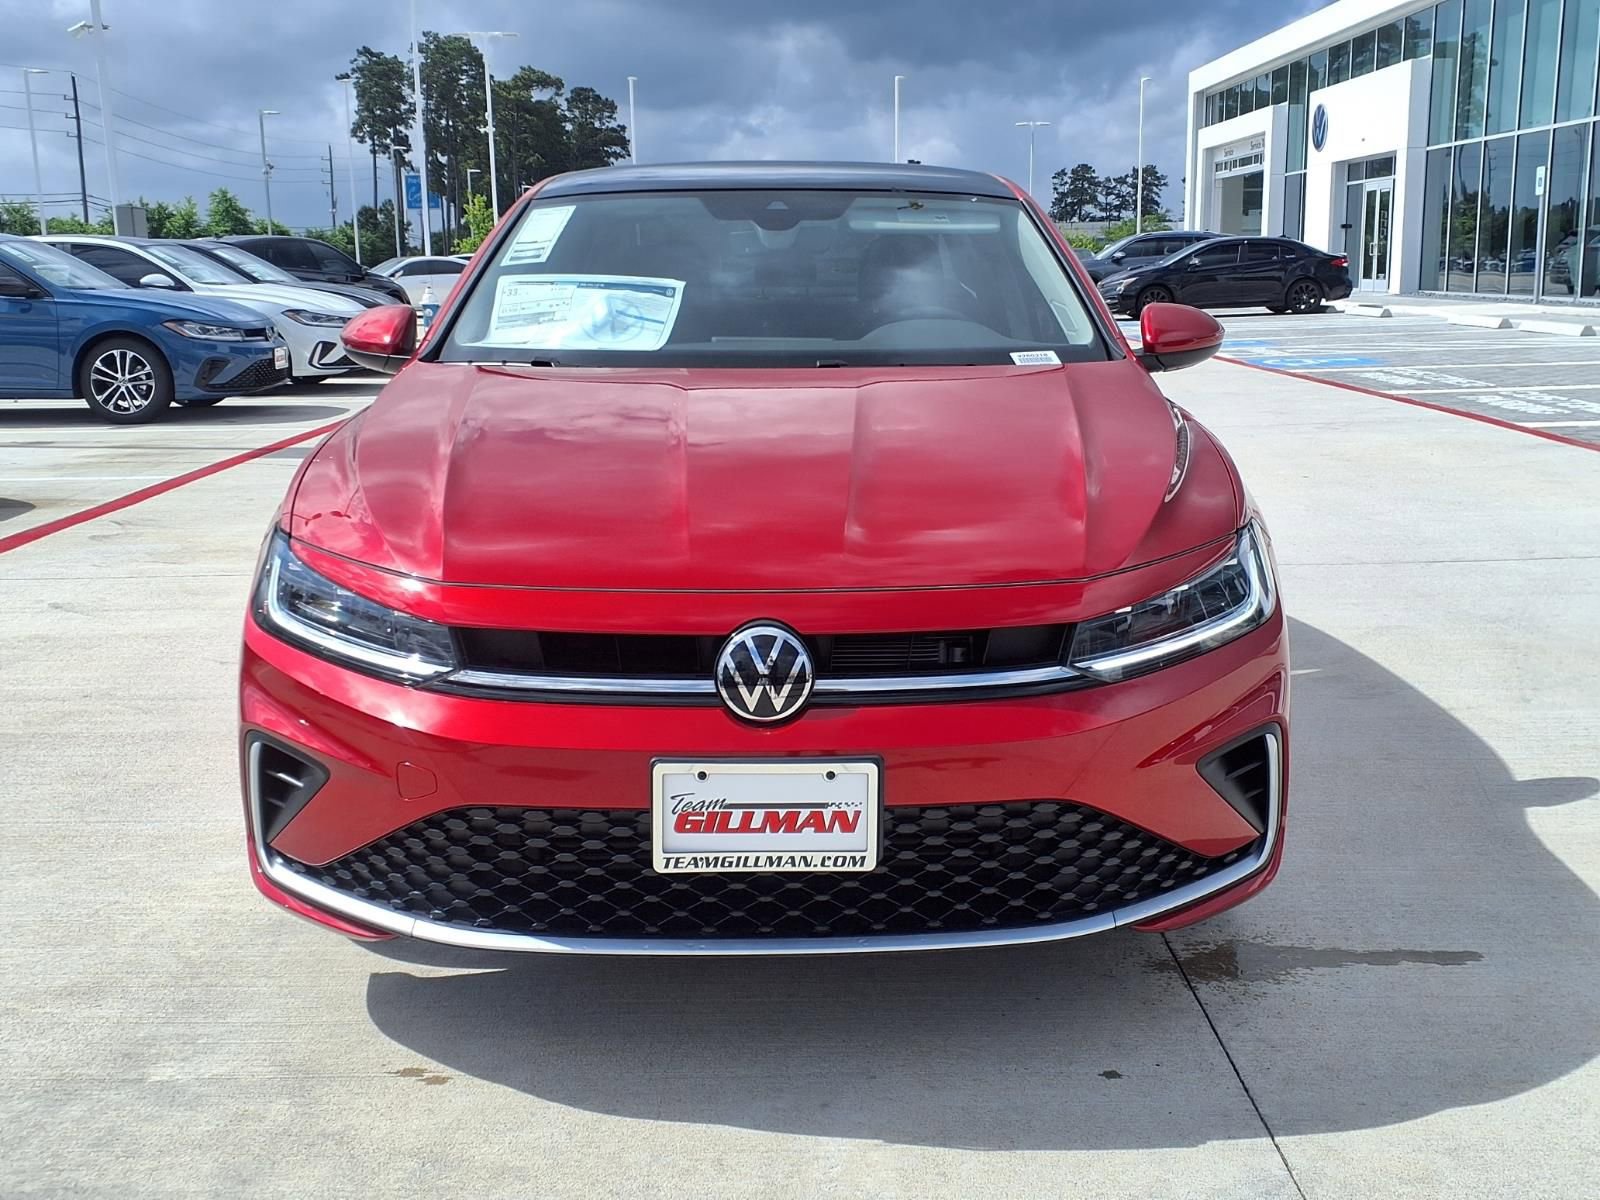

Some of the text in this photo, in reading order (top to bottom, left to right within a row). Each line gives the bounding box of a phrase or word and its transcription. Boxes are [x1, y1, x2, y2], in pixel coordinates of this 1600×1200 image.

[721, 629, 809, 716] VW
[670, 792, 727, 815] Team
[673, 810, 862, 834] GILLMAN
[662, 855, 867, 869] TEAMGILLMAN.COM
